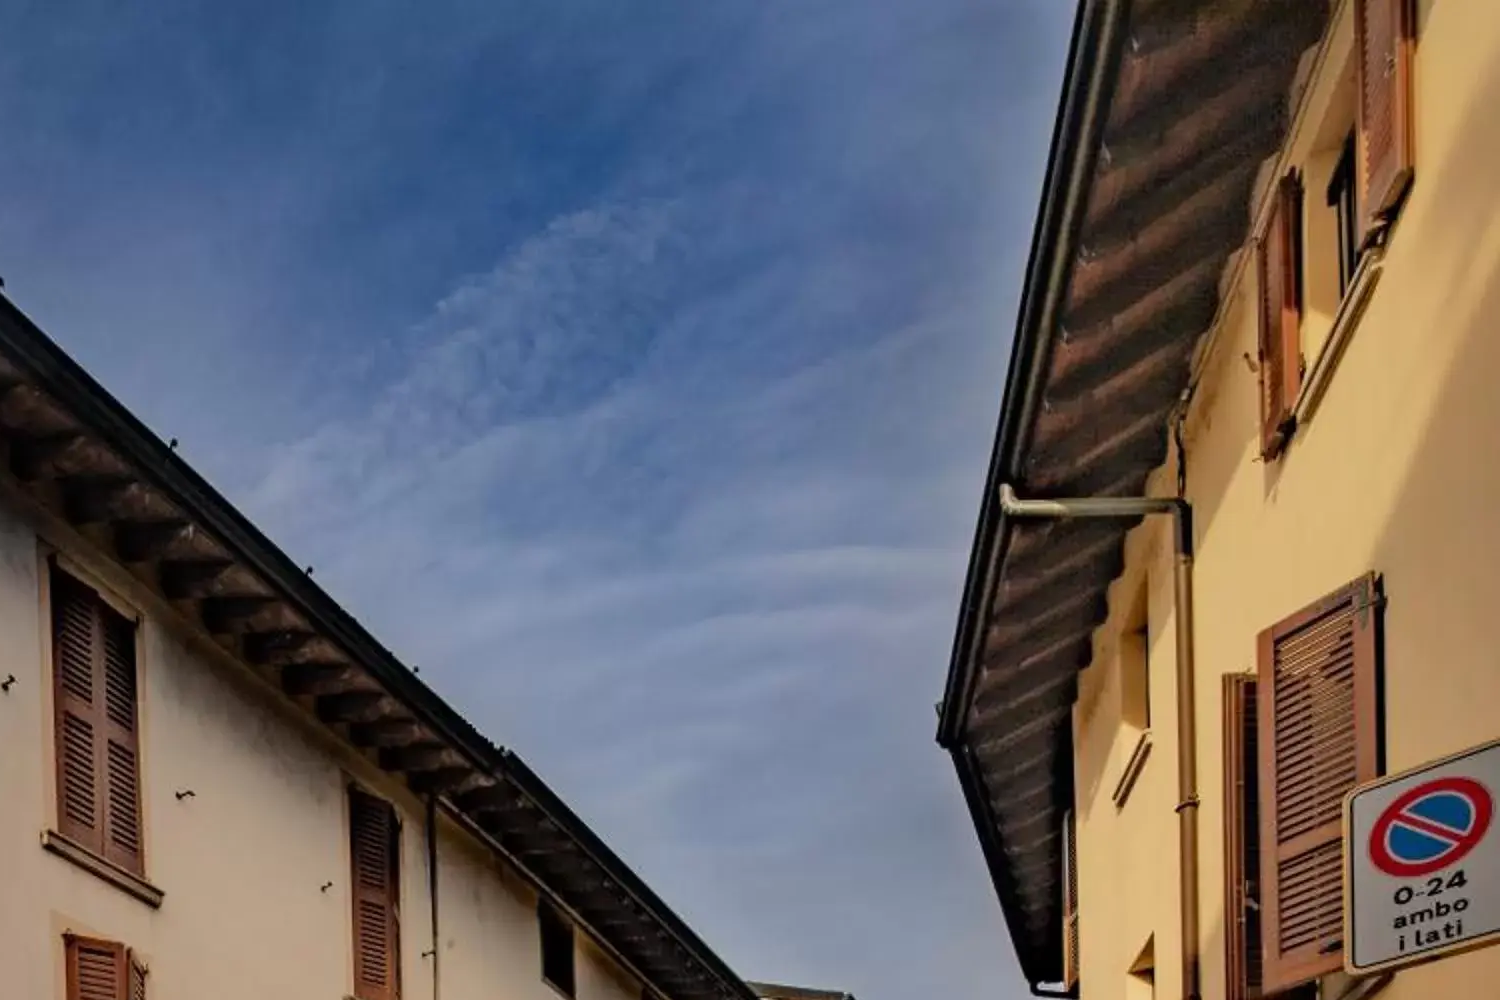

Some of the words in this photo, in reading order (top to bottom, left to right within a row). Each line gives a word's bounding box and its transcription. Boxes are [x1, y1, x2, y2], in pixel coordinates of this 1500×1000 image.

[1393, 868, 1468, 905] 0-24
[1393, 898, 1469, 929] ambo
[1399, 935, 1405, 951] i
[1415, 919, 1462, 947] lati
